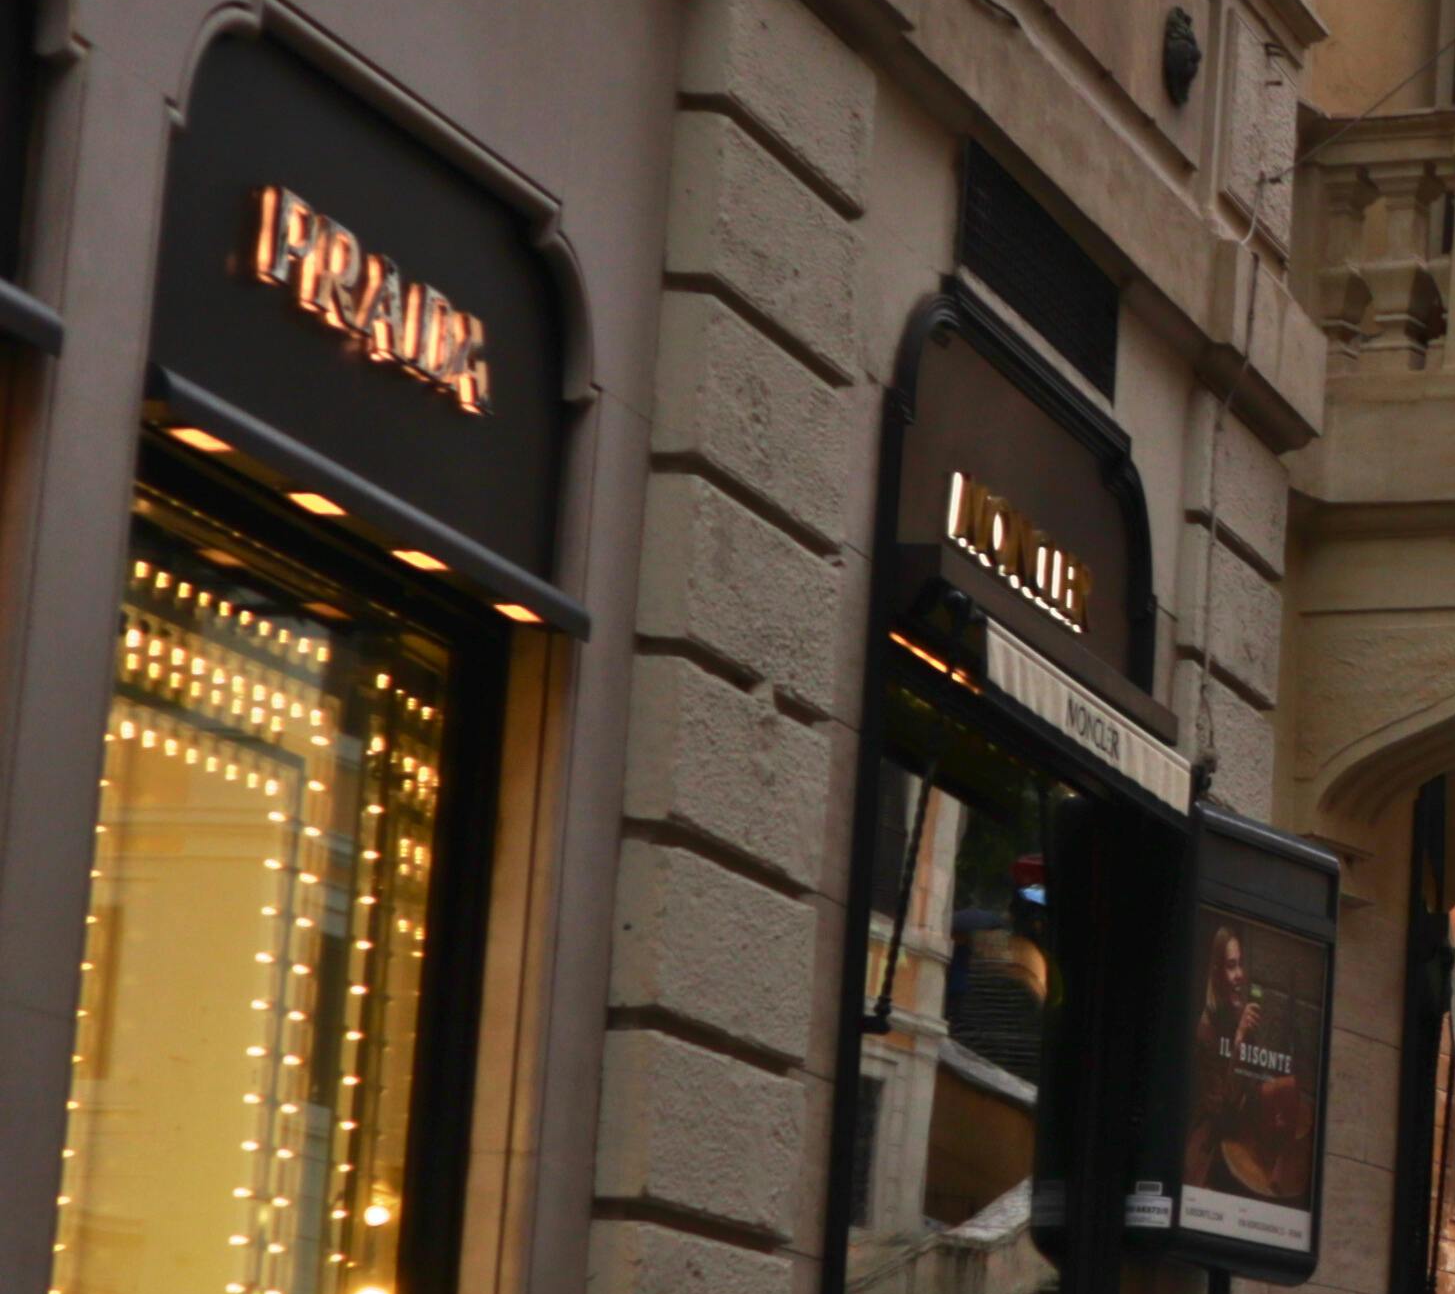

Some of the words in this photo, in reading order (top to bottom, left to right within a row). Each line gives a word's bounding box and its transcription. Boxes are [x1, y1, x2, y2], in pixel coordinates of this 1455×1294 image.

[256, 184, 493, 415] PRADA
[1065, 696, 1120, 762] MONCLER
[1219, 1036, 1232, 1059] IL
[1239, 1042, 1292, 1074] BISONTE
